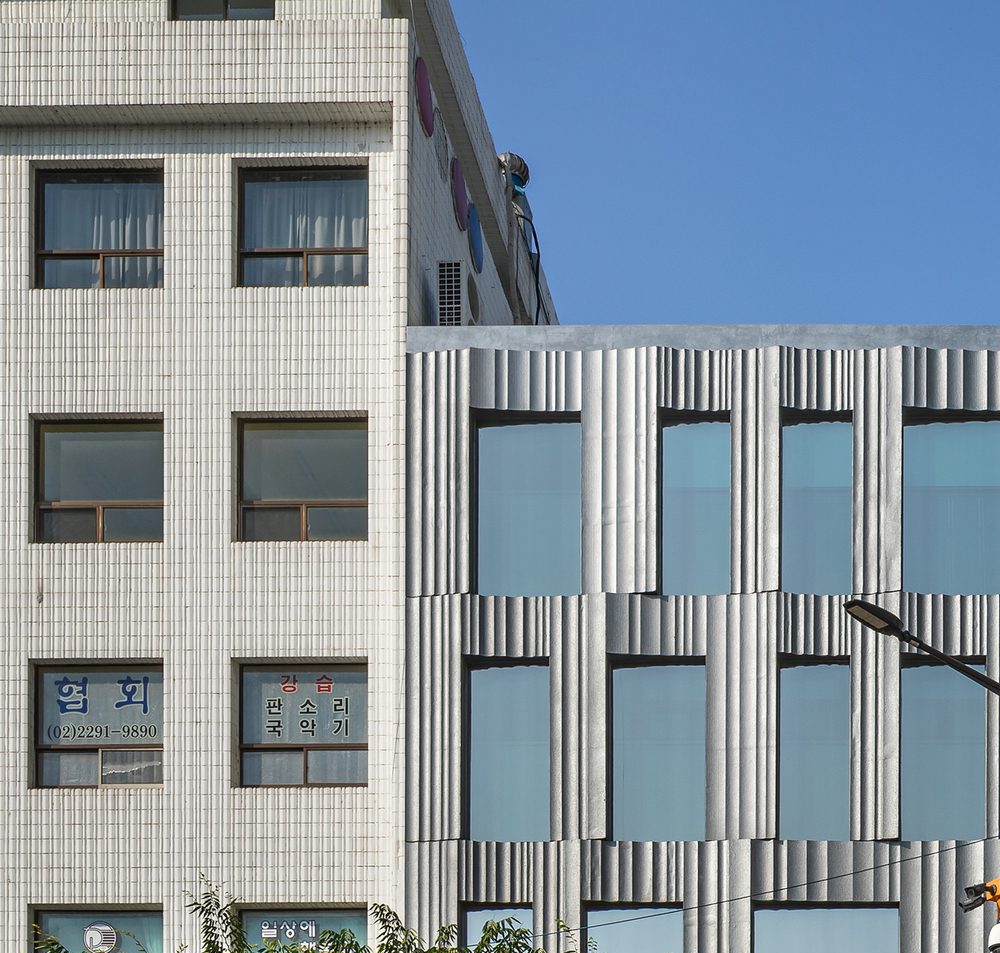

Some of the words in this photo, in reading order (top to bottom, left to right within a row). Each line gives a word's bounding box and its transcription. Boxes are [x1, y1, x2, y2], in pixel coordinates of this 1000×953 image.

[280, 674, 334, 693] 강습
[54, 675, 151, 715] 협회
[265, 697, 350, 716] 판소리
[47, 723, 158, 740] (02)2291-9890
[265, 719, 350, 737] 국악기
[261, 920, 316, 938] 일상에
